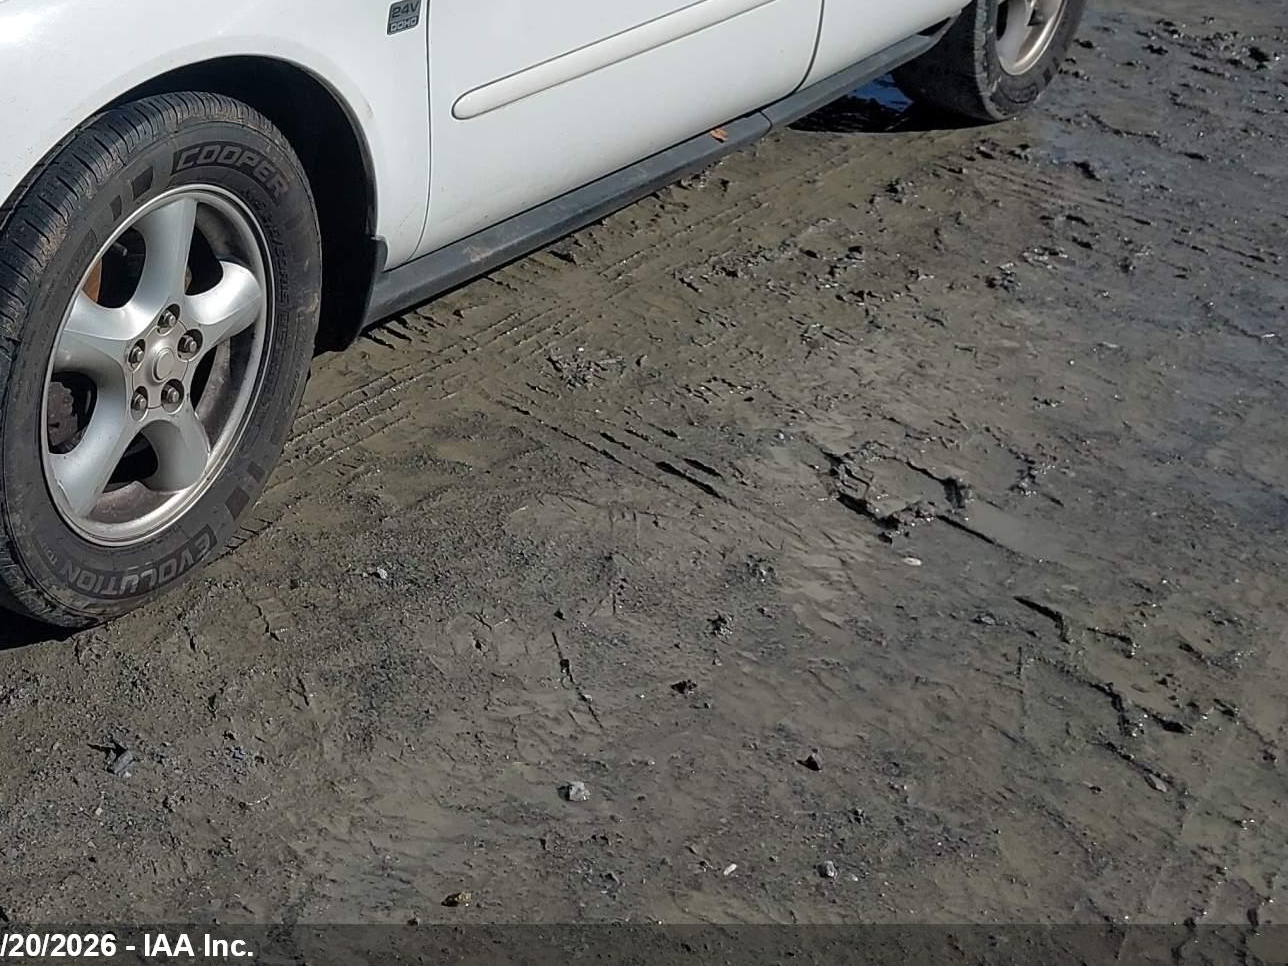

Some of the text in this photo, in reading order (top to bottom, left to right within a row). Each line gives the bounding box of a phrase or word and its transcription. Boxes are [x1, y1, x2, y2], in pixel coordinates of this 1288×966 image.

[392, 0, 420, 19] 24V
[175, 144, 290, 201] COOPER
[63, 532, 211, 595] EVOLUTION
